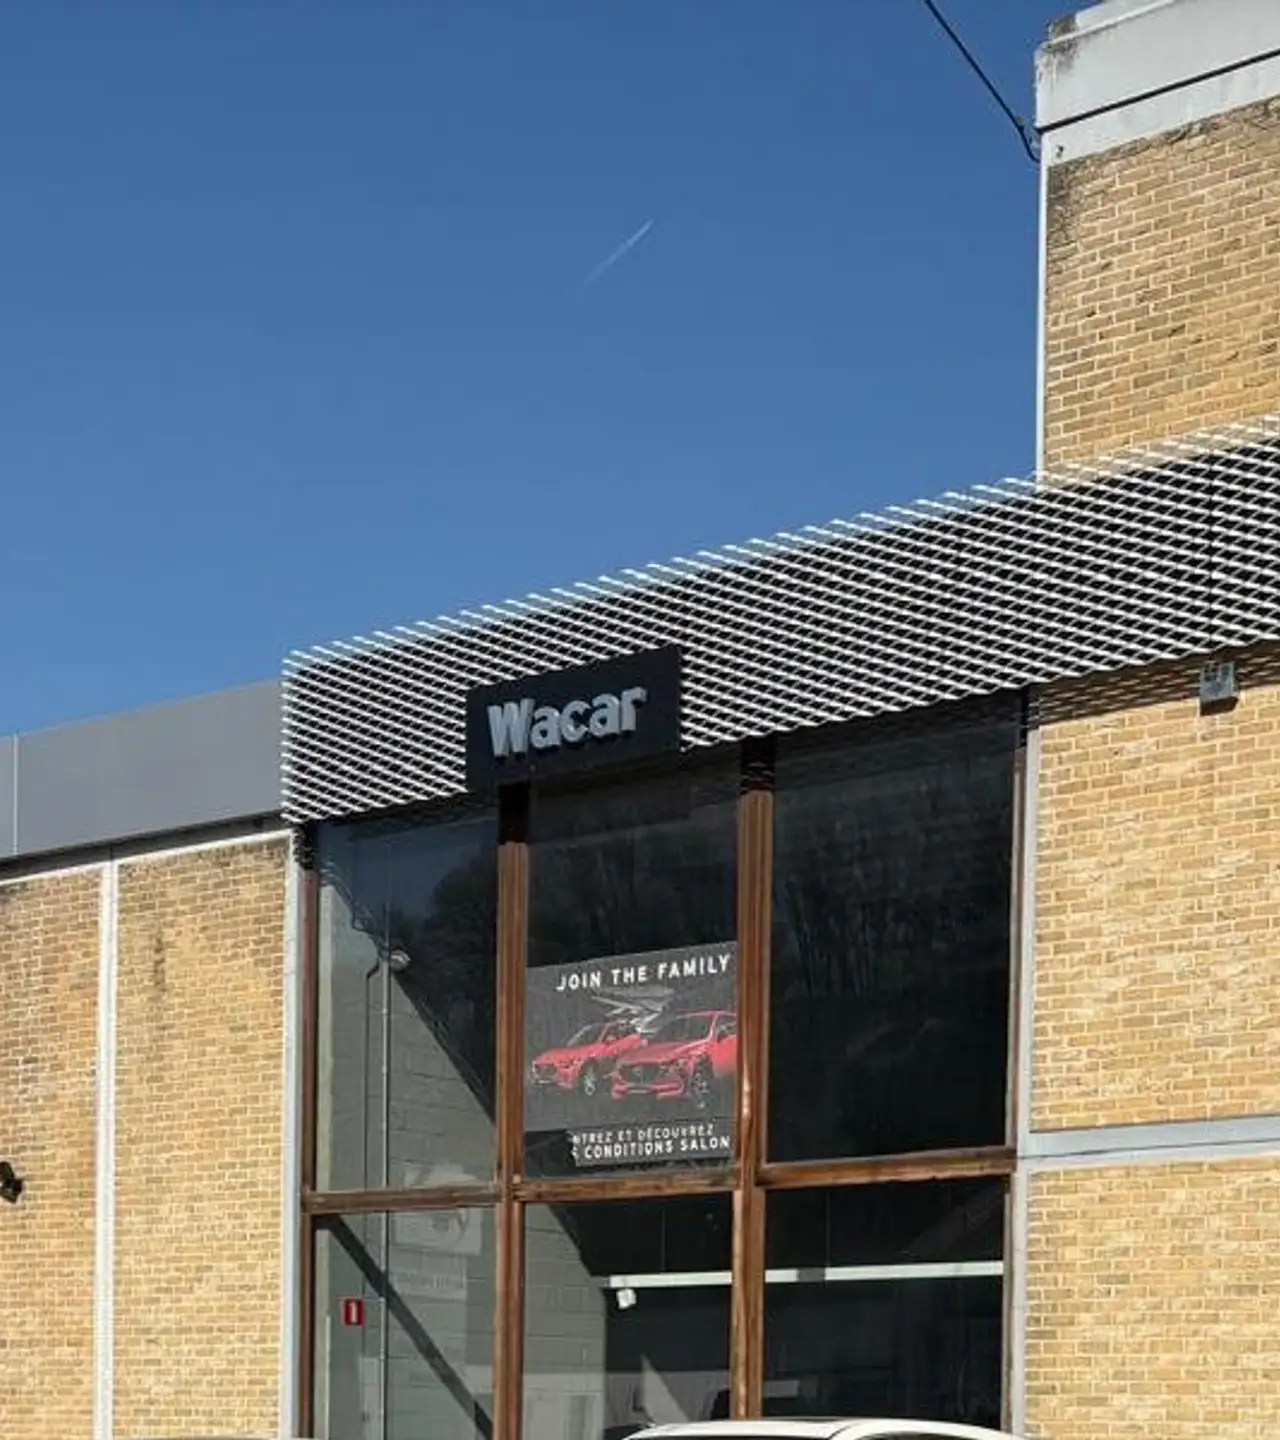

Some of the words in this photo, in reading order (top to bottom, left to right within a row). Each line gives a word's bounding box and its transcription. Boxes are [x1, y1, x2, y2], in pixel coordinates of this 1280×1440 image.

[487, 687, 648, 757] Wacar
[555, 971, 602, 992] JOIN
[611, 965, 648, 985] THE
[657, 954, 731, 980] FAMILY
[570, 1131, 613, 1146] NTREZ
[617, 1129, 633, 1142] ET
[584, 1140, 674, 1160] CONDITIONS
[679, 1136, 730, 1152] SALON
